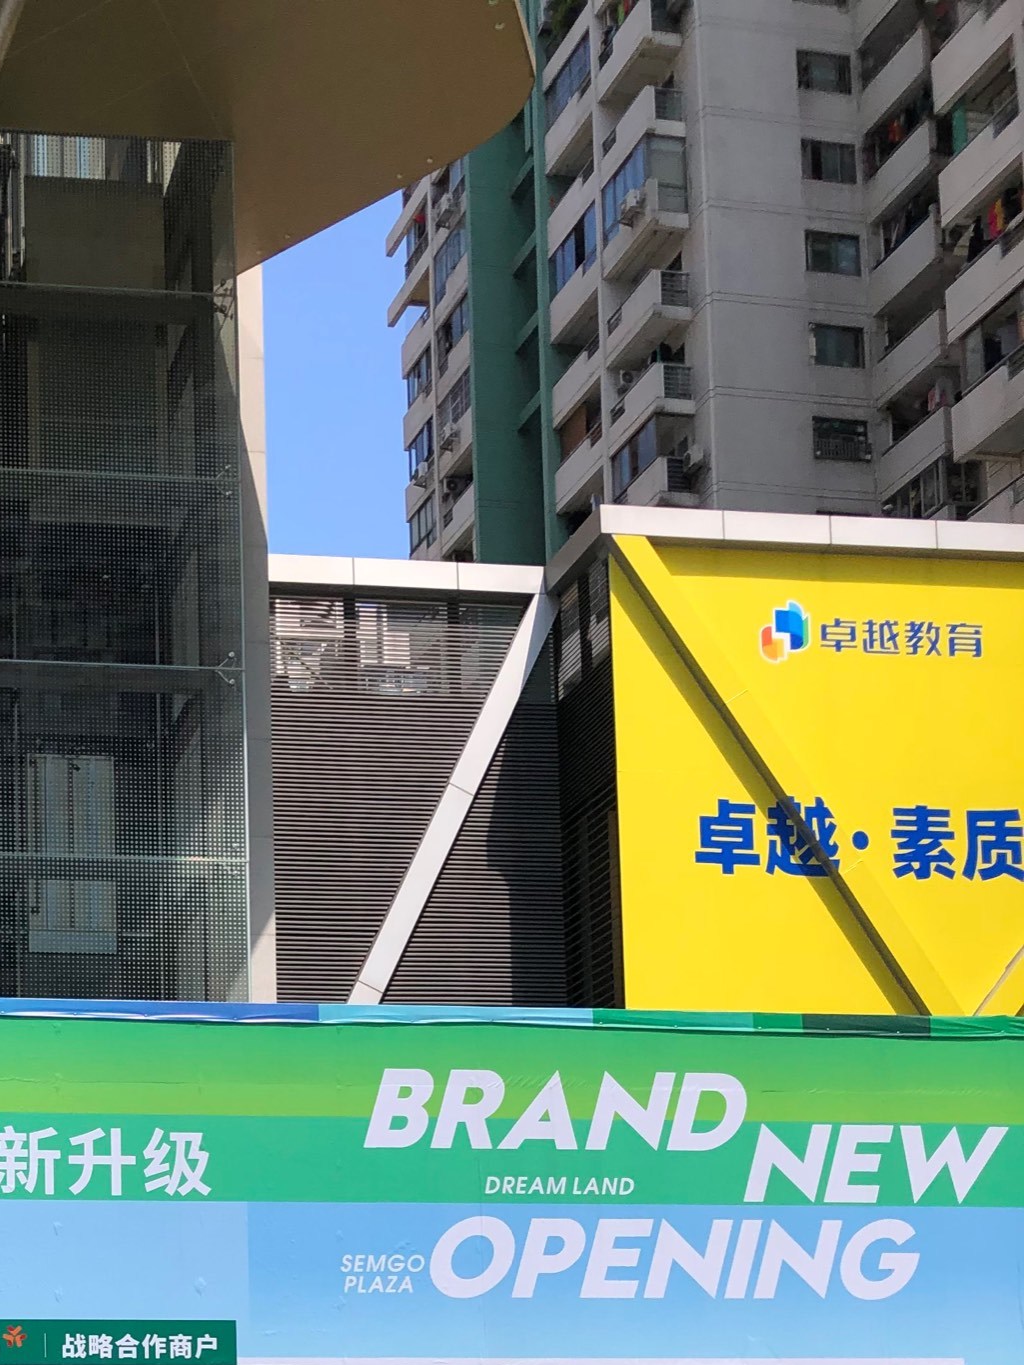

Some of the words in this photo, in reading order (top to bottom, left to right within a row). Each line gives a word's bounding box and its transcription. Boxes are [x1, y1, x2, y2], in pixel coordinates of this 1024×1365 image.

[820, 617, 984, 658] 卓越教育
[363, 1068, 748, 1152] BRAND
[743, 1122, 1009, 1205] NEW
[484, 1175, 567, 1195] DREAM
[572, 1176, 636, 1196] LAND
[340, 1253, 425, 1273] SEMGO
[429, 1215, 921, 1301] OPENING
[343, 1274, 415, 1294] PLAZA
[61, 1333, 219, 1361] 战略合作商户
